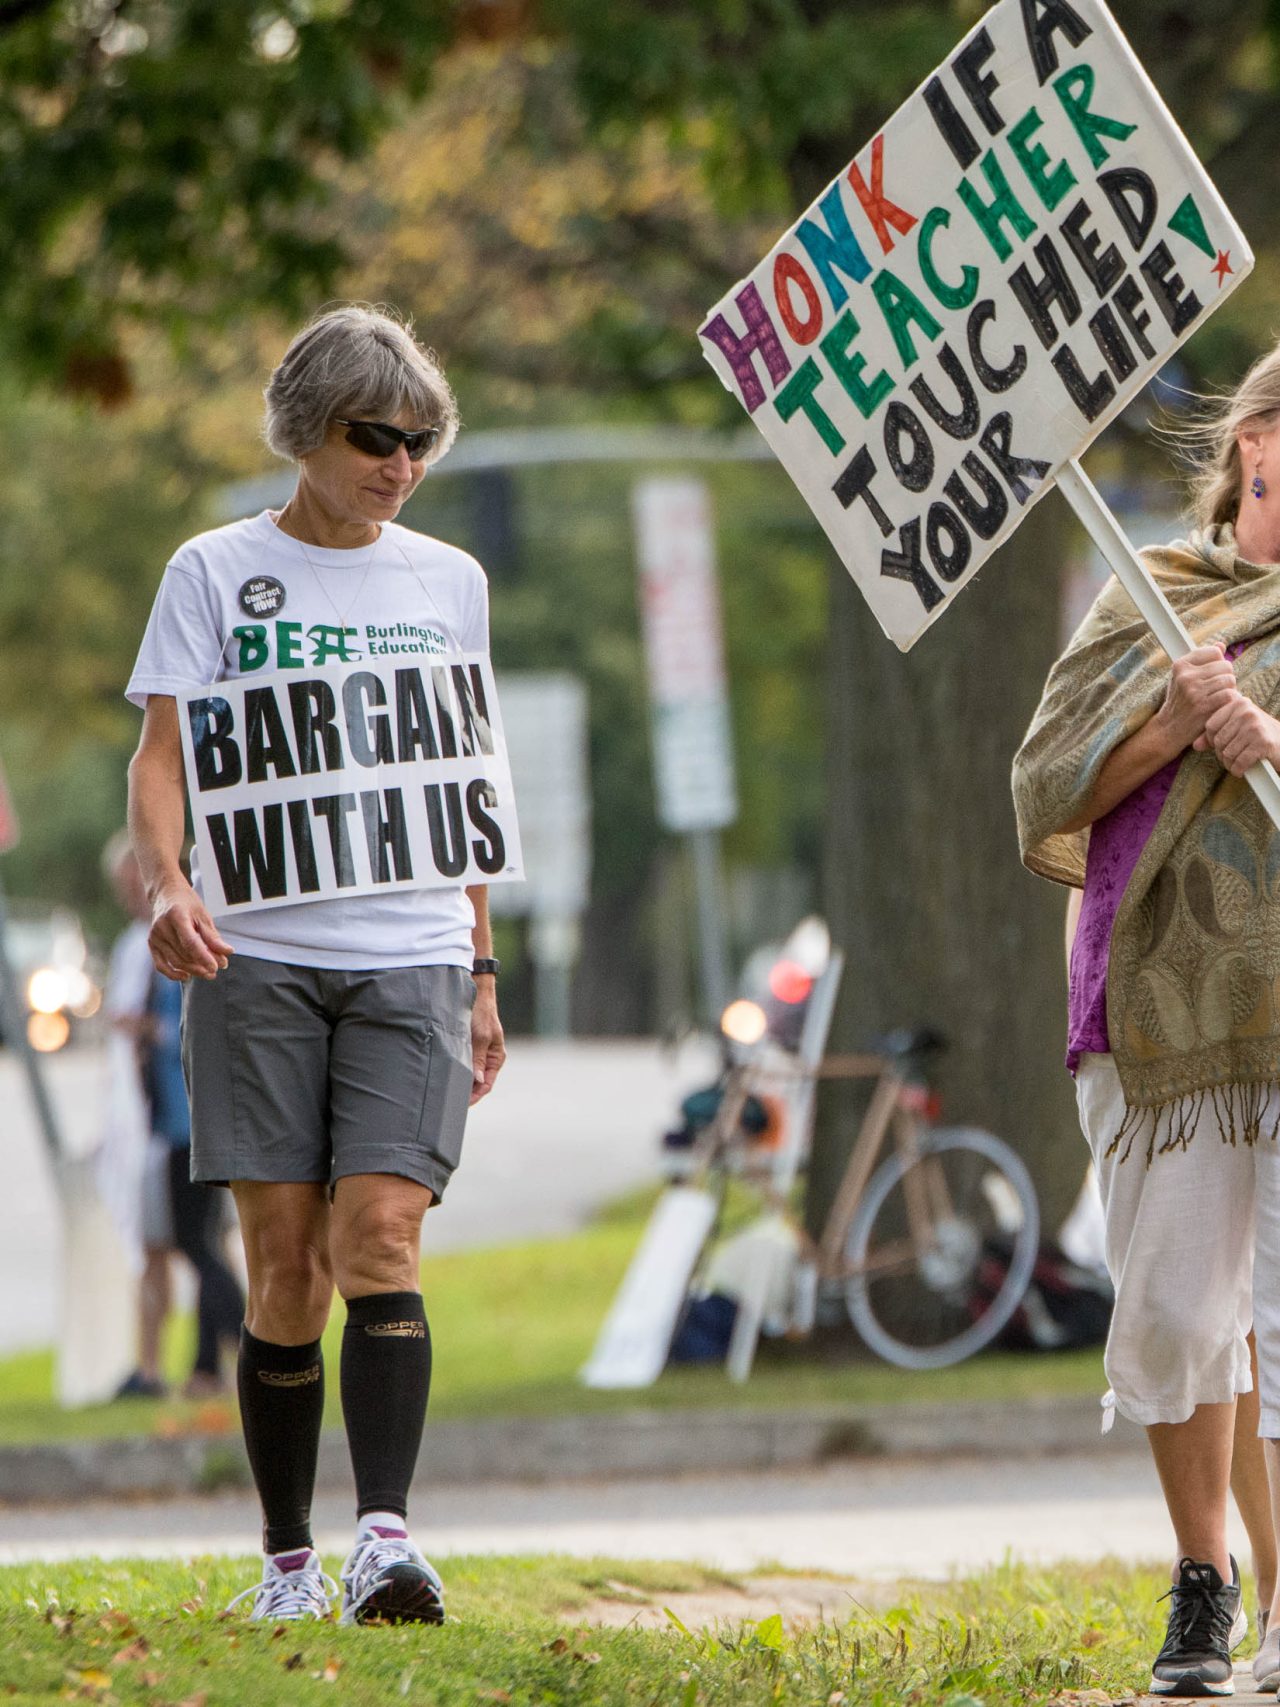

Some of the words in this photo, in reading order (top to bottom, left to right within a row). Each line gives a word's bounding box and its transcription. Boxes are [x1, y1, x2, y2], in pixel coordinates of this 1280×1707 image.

[700, 134, 918, 414] HONK
[922, 26, 1006, 170] IF
[1020, 0, 1094, 87] A
[773, 63, 1138, 457] TEACHER
[831, 167, 1158, 538] TOUCHED
[880, 411, 1052, 613] YOUR
[244, 587, 281, 604] Contract
[249, 582, 266, 593] Fair
[366, 623, 446, 648] Burlington
[187, 664, 495, 792] BARGAIN
[205, 787, 414, 906] WITH
[423, 778, 506, 878] US
[364, 1321, 424, 1331] COPPER
